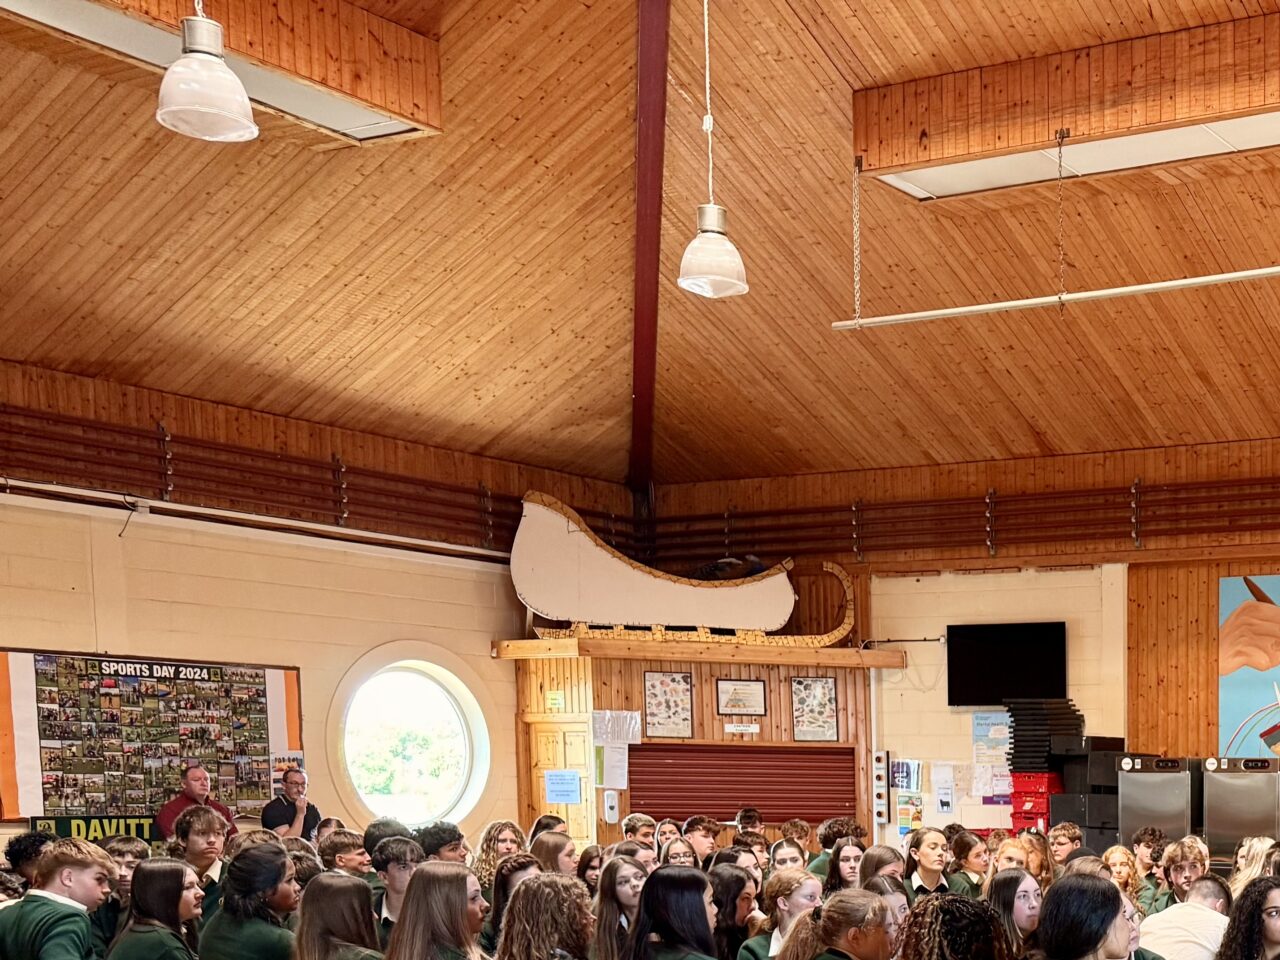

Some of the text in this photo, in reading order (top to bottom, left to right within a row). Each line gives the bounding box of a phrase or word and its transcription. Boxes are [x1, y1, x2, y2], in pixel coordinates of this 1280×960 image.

[101, 662, 208, 679] SPORTS DAY 2024
[71, 818, 153, 840] DAVITT
